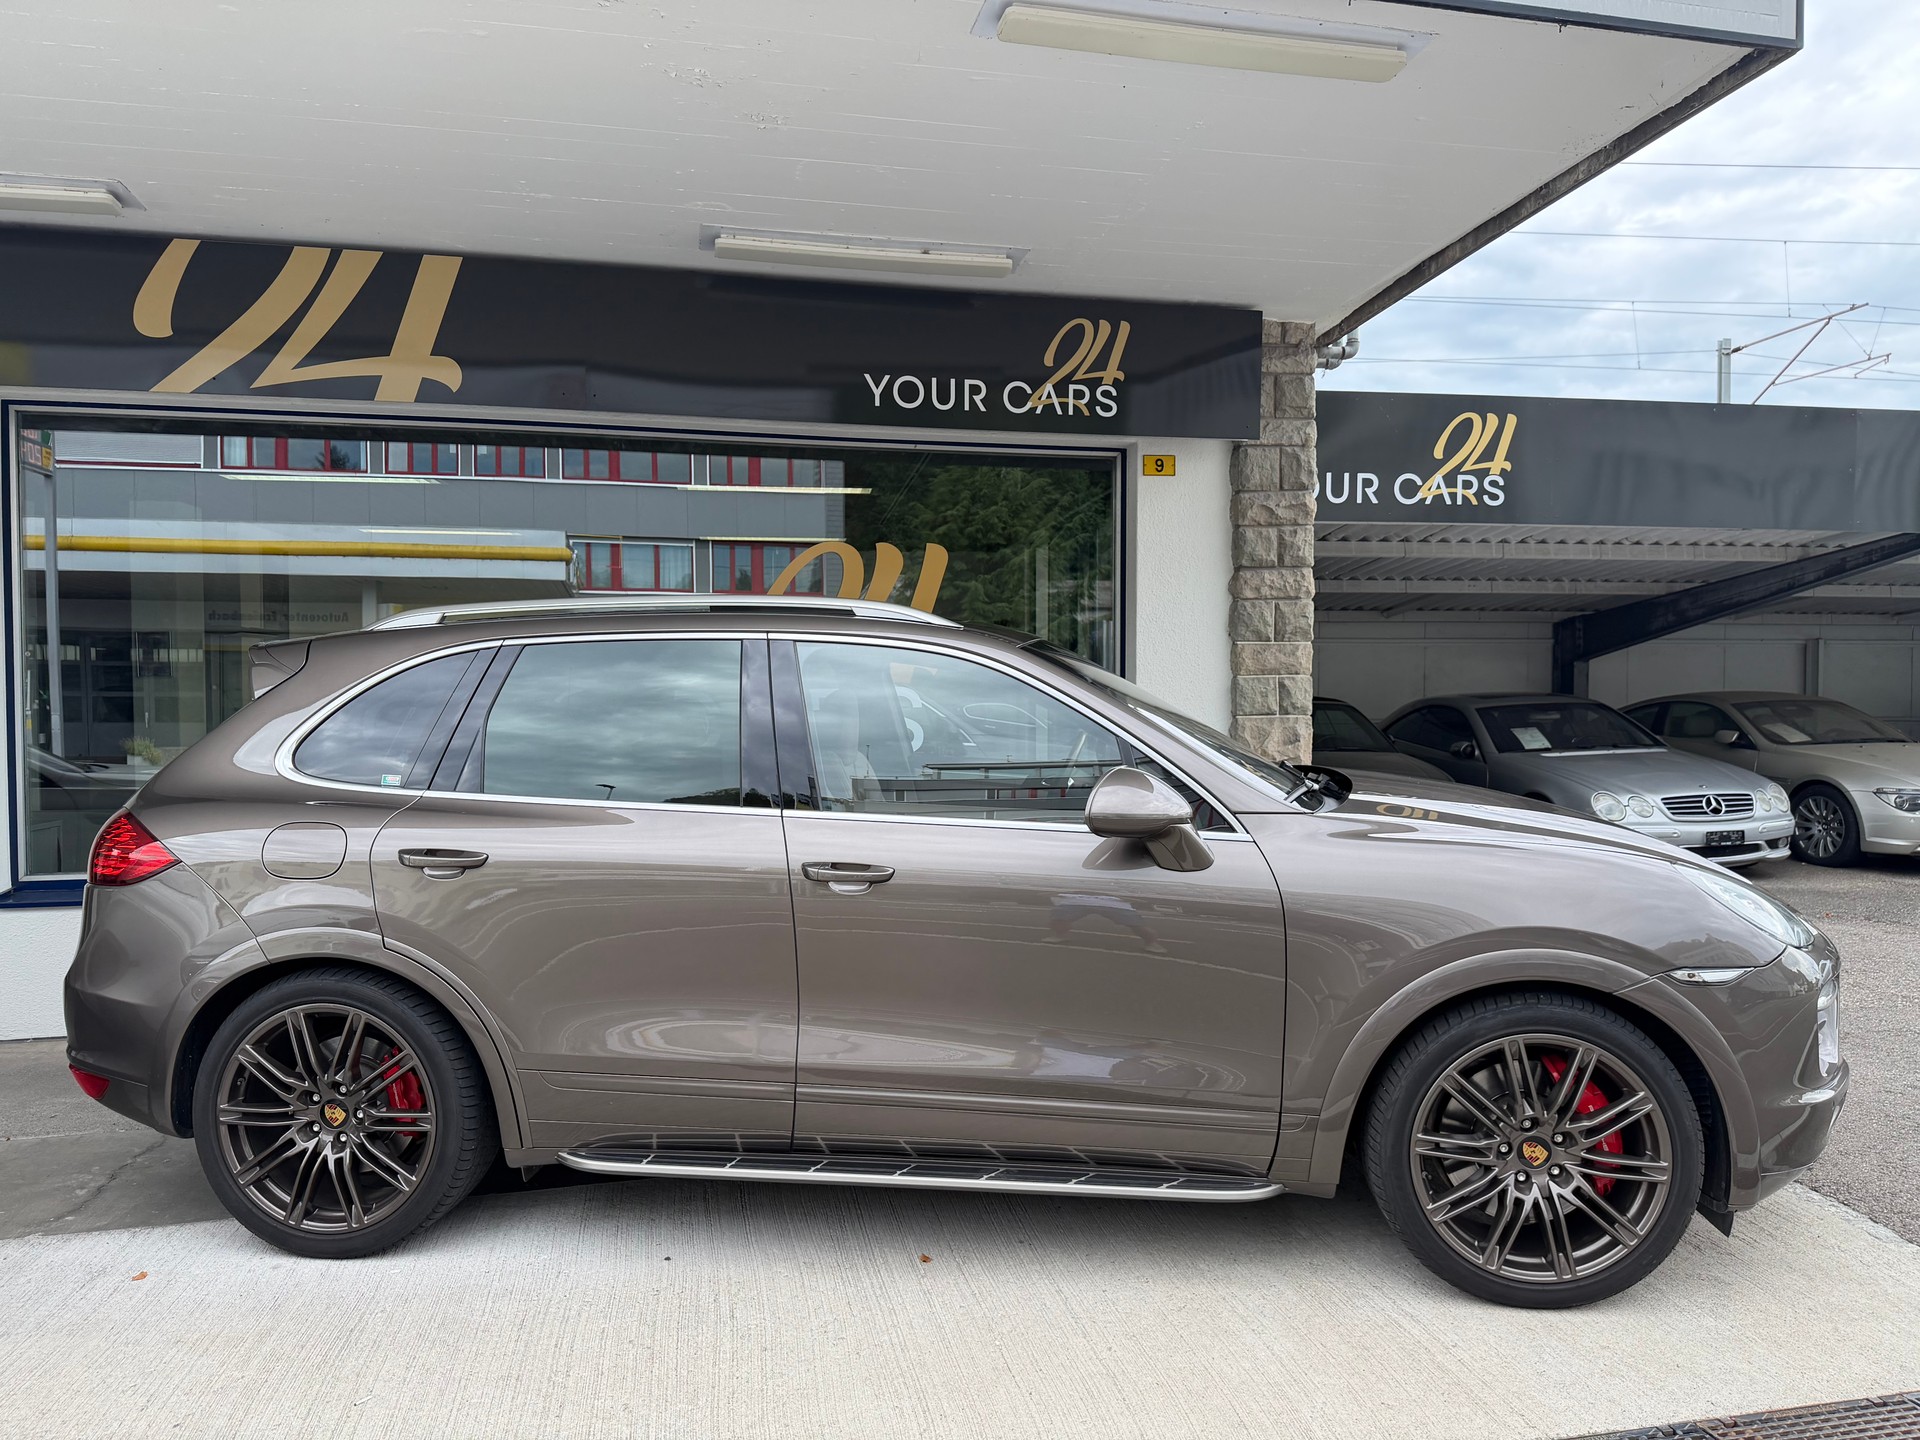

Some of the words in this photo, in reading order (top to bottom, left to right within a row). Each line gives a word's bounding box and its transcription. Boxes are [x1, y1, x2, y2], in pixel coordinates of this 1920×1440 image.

[132, 238, 464, 403] 24
[863, 373, 987, 412] YOUR
[1002, 381, 1118, 418] CARS
[1030, 317, 1131, 416] 24
[1154, 458, 1164, 473] 9
[1313, 471, 1379, 504] UR
[1393, 472, 1506, 507] CARS
[1419, 411, 1518, 505] 24
